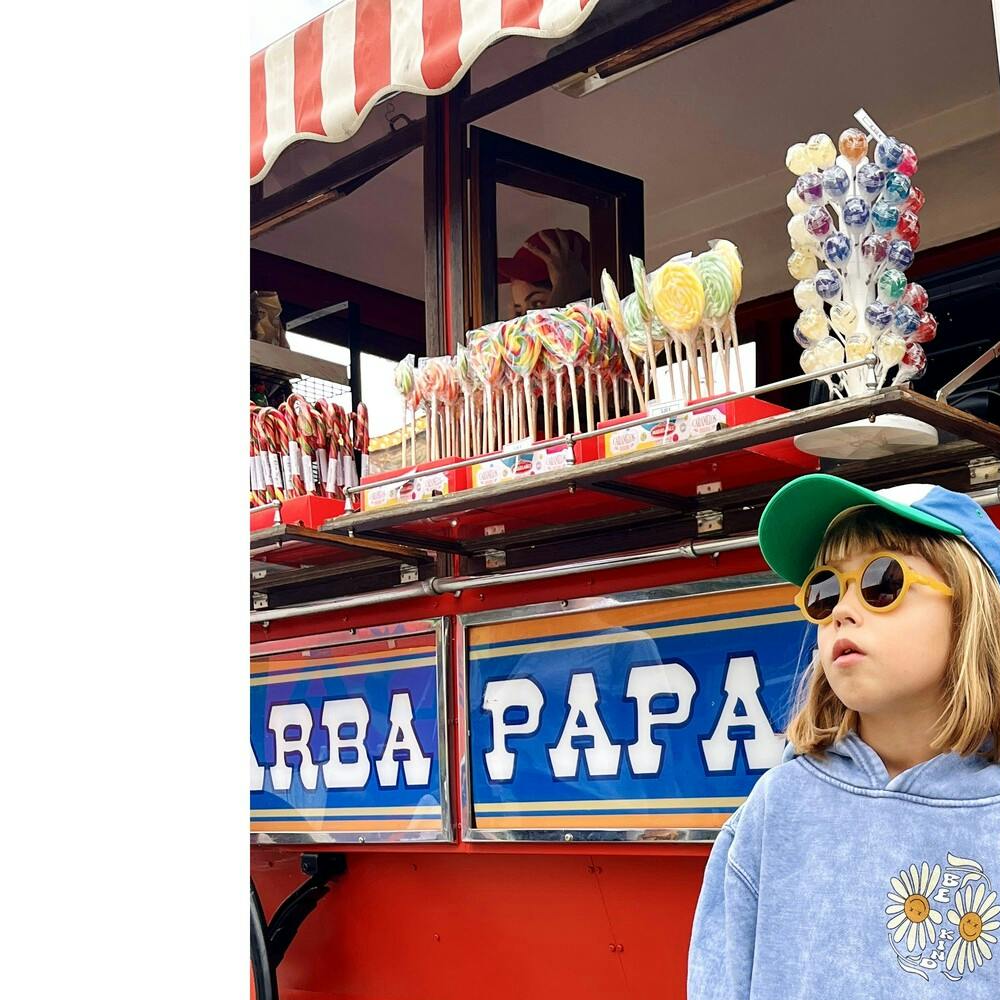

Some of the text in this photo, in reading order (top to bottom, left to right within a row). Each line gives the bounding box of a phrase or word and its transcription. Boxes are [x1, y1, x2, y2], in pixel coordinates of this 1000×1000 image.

[482, 655, 789, 782] PAPA
[933, 872, 961, 904] BE
[918, 928, 954, 970] KIND
